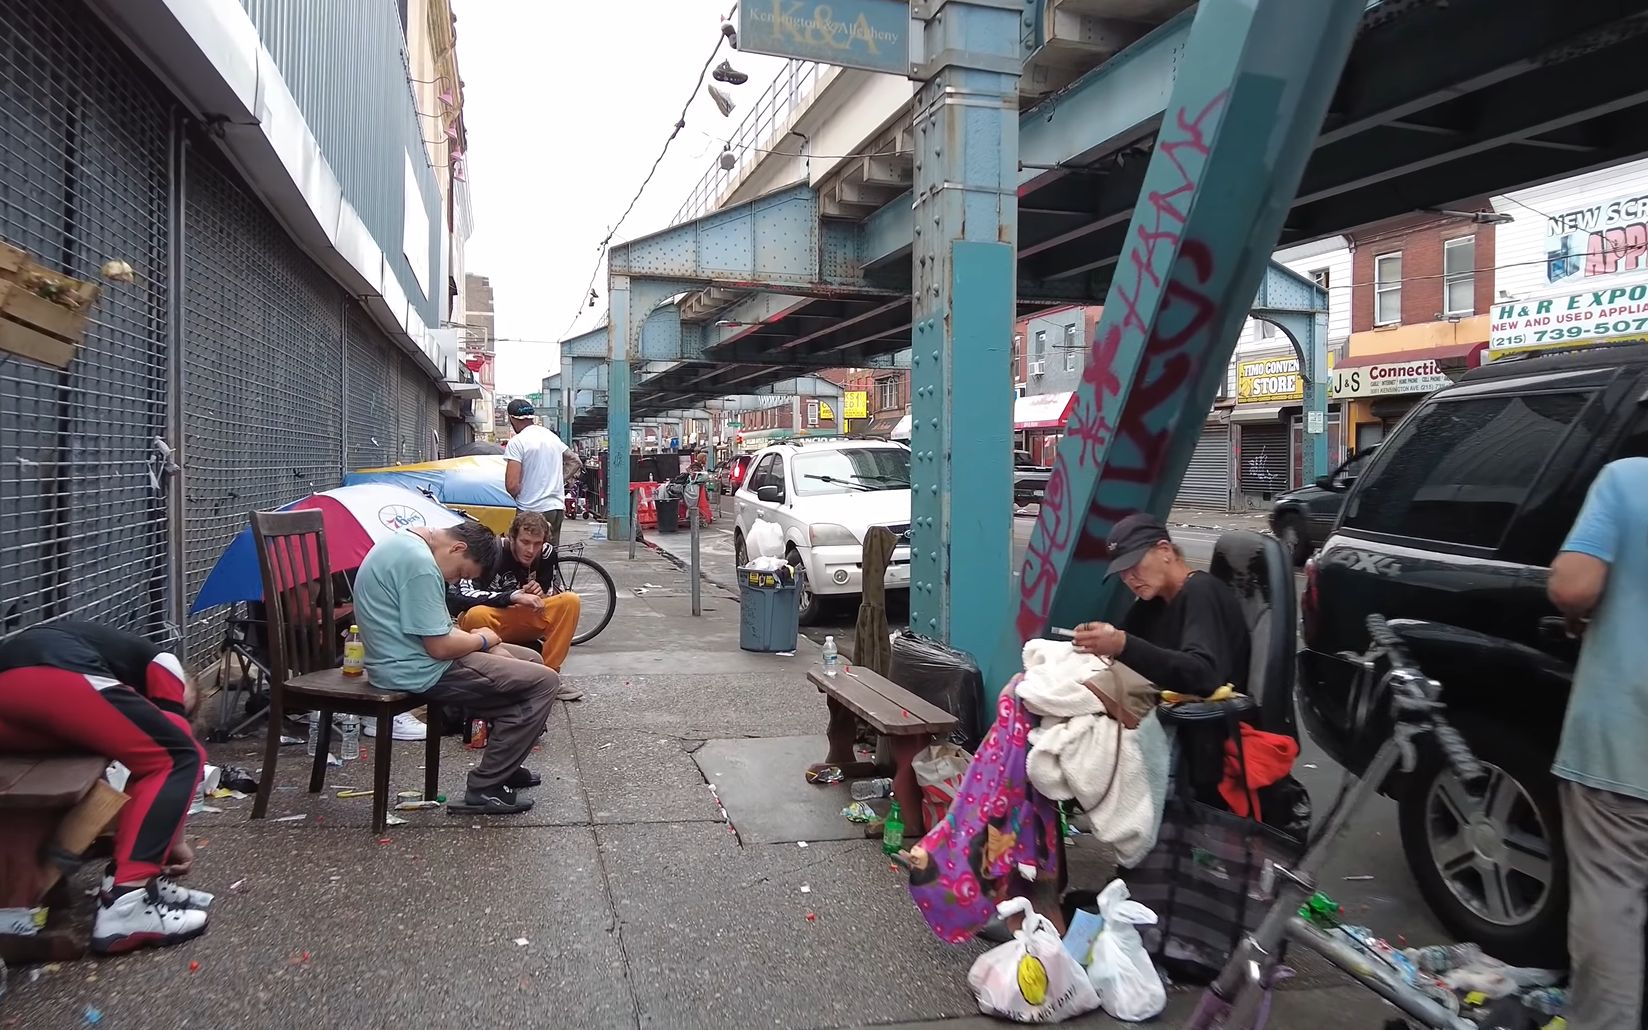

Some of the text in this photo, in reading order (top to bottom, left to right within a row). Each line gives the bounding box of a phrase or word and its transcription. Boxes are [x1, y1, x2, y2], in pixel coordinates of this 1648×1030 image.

[1548, 206, 1601, 237] NEW
[1584, 223, 1648, 277] APP
[1499, 285, 1647, 319] H & R EXPO
[1492, 320, 1518, 332] NEW
[1524, 316, 1550, 328] AND
[1556, 311, 1593, 323] USED
[1492, 333, 1526, 346] (215)
[1253, 375, 1296, 395] STORE
[1335, 373, 1342, 393] J
[1351, 372, 1360, 392] S
